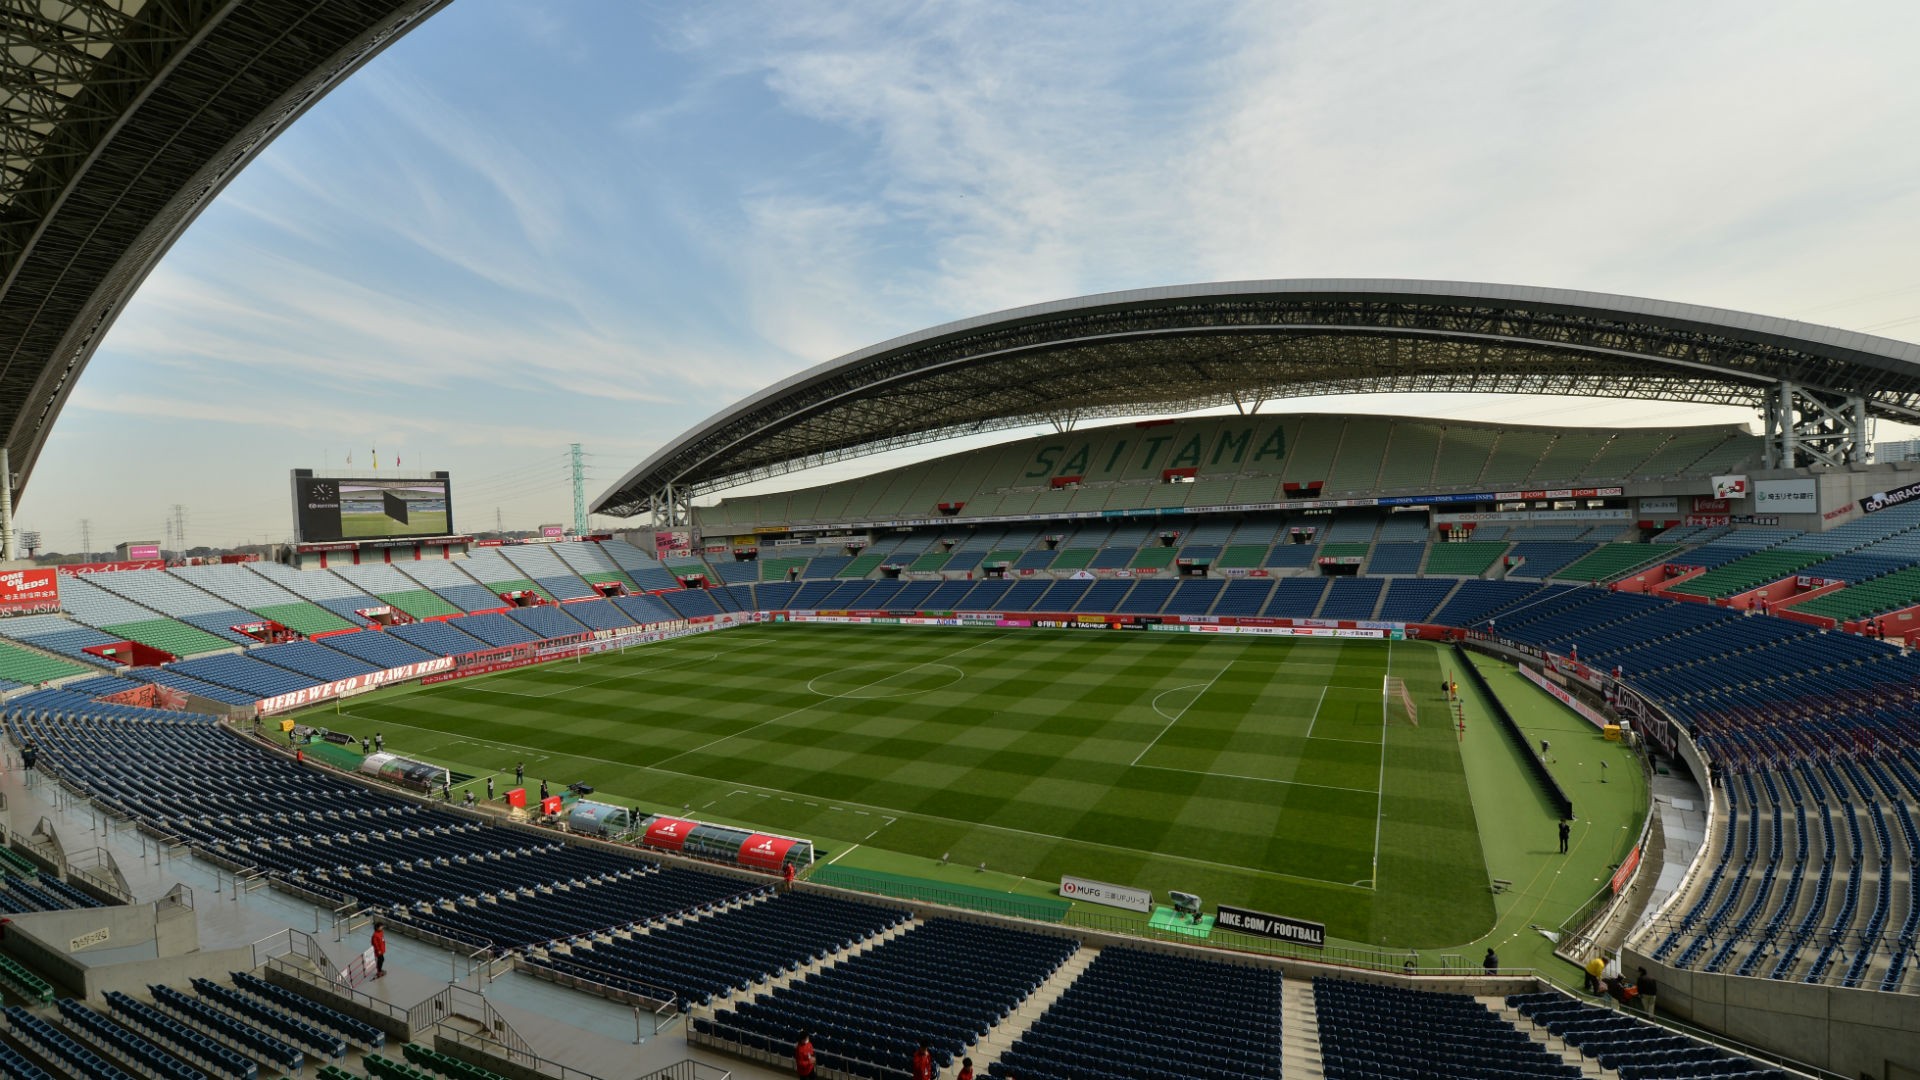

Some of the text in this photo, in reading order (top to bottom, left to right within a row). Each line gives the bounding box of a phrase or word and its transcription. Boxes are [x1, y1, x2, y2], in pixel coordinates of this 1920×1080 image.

[1025, 424, 1286, 479] SAITAMA
[1575, 489, 1594, 497] J:COM
[1866, 499, 1883, 511] GO
[1884, 484, 1920, 506] MIRAC
[16, 577, 49, 592] REDS!
[454, 649, 513, 666] Welcome
[261, 690, 306, 713] HERE
[308, 683, 333, 702] WE
[334, 677, 358, 694] GO
[363, 663, 414, 687] URAWA
[415, 656, 453, 676] REDS
[1077, 885, 1100, 897] MUFG
